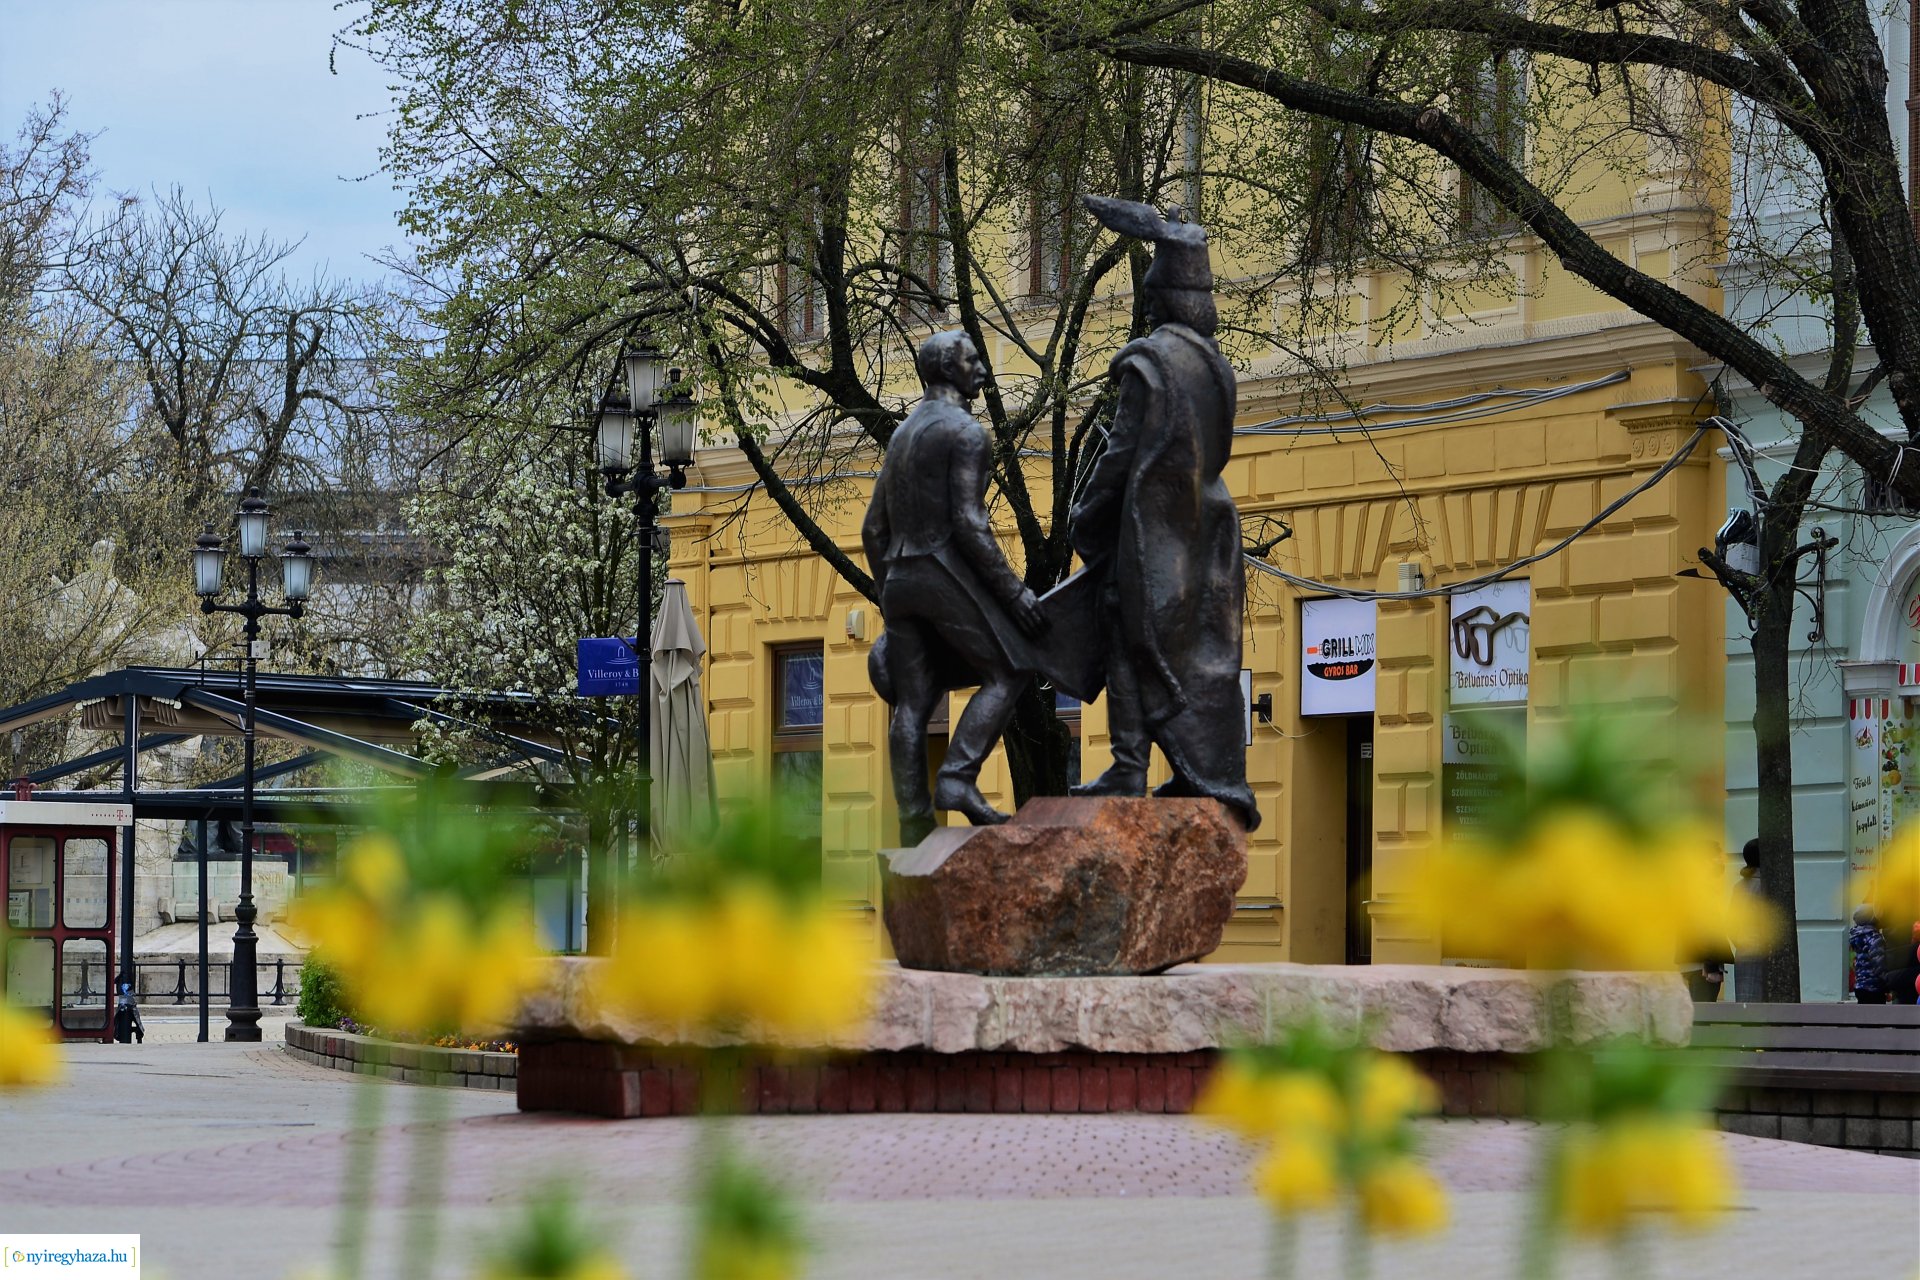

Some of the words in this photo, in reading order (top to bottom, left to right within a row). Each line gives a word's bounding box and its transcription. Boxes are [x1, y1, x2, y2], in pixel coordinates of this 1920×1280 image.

[1322, 637, 1354, 659] GRILL
[588, 669, 623, 681] Villeroy
[624, 670, 631, 678] &
[1324, 665, 1344, 677] GYROS
[1345, 664, 1359, 676] BAR
[1456, 669, 1497, 689] Belvárosi
[1499, 667, 1529, 689] Optika
